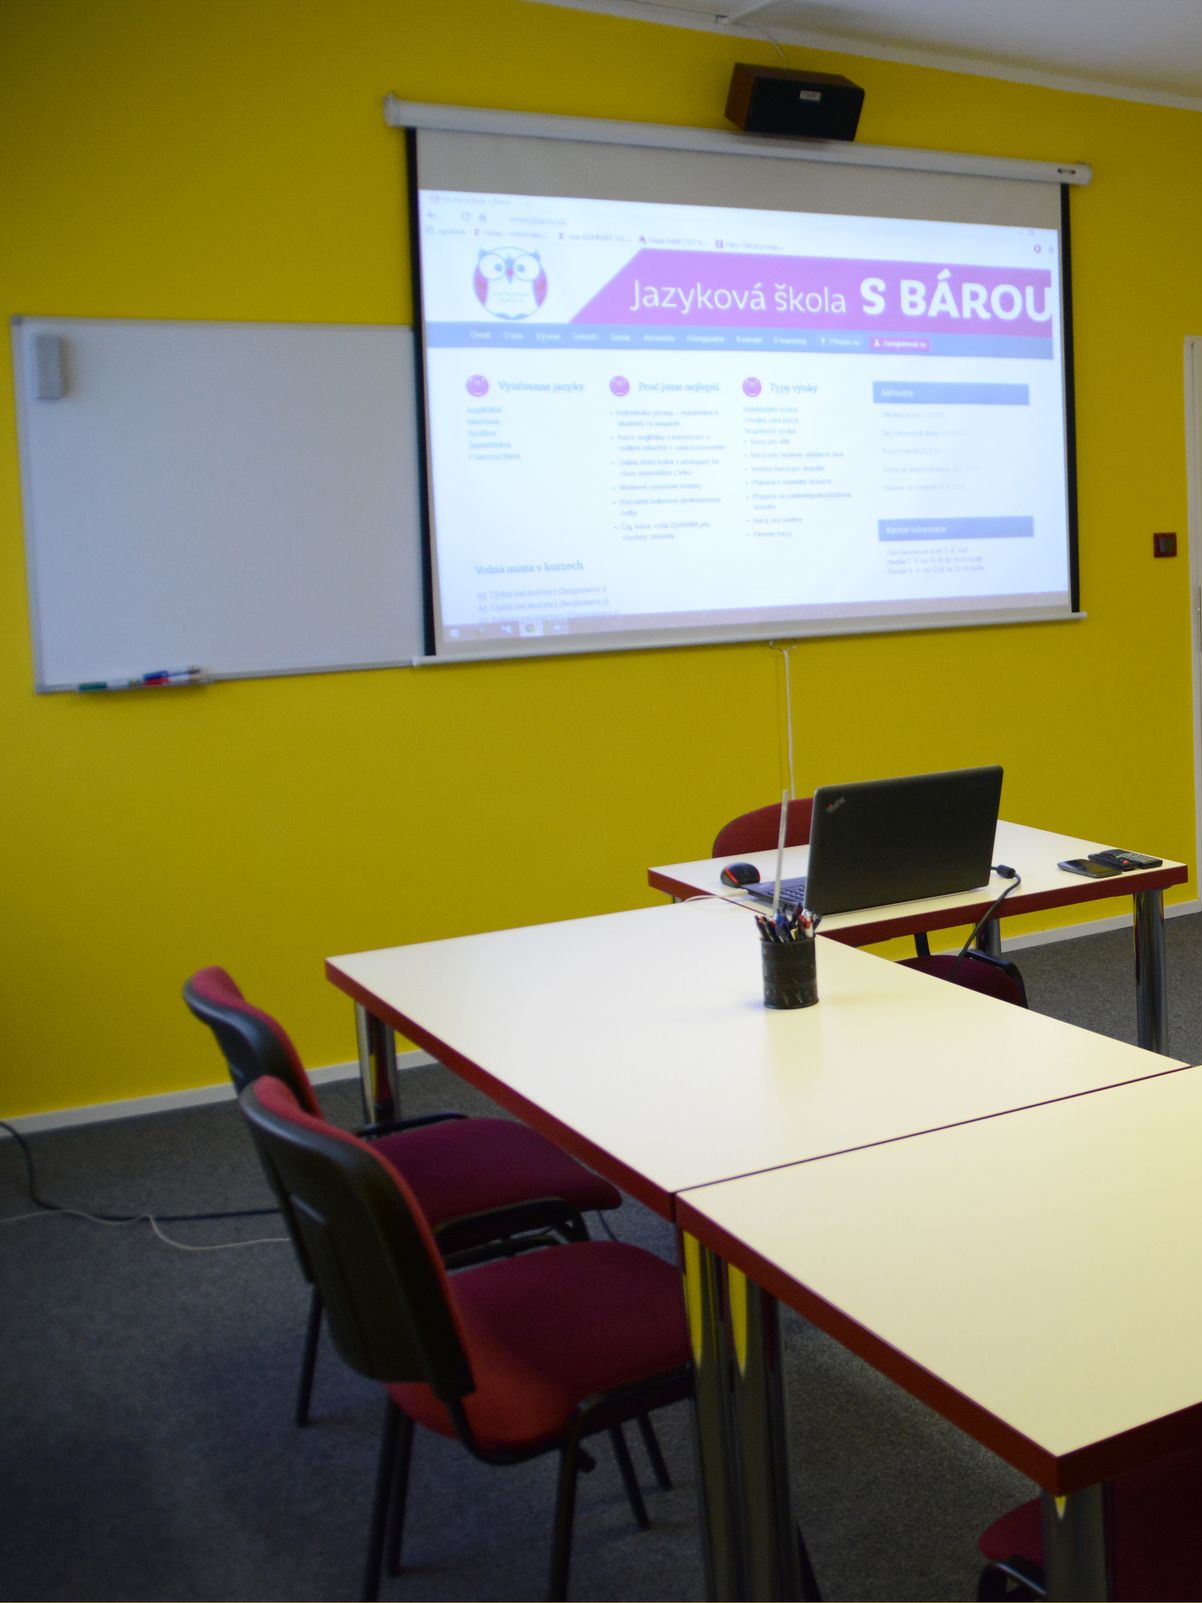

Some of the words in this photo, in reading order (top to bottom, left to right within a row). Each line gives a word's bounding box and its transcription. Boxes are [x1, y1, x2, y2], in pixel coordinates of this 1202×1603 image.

[629, 279, 766, 314] Jazyková
[773, 282, 847, 313] škola
[859, 276, 887, 316] S
[899, 267, 1052, 322] BÁROU
